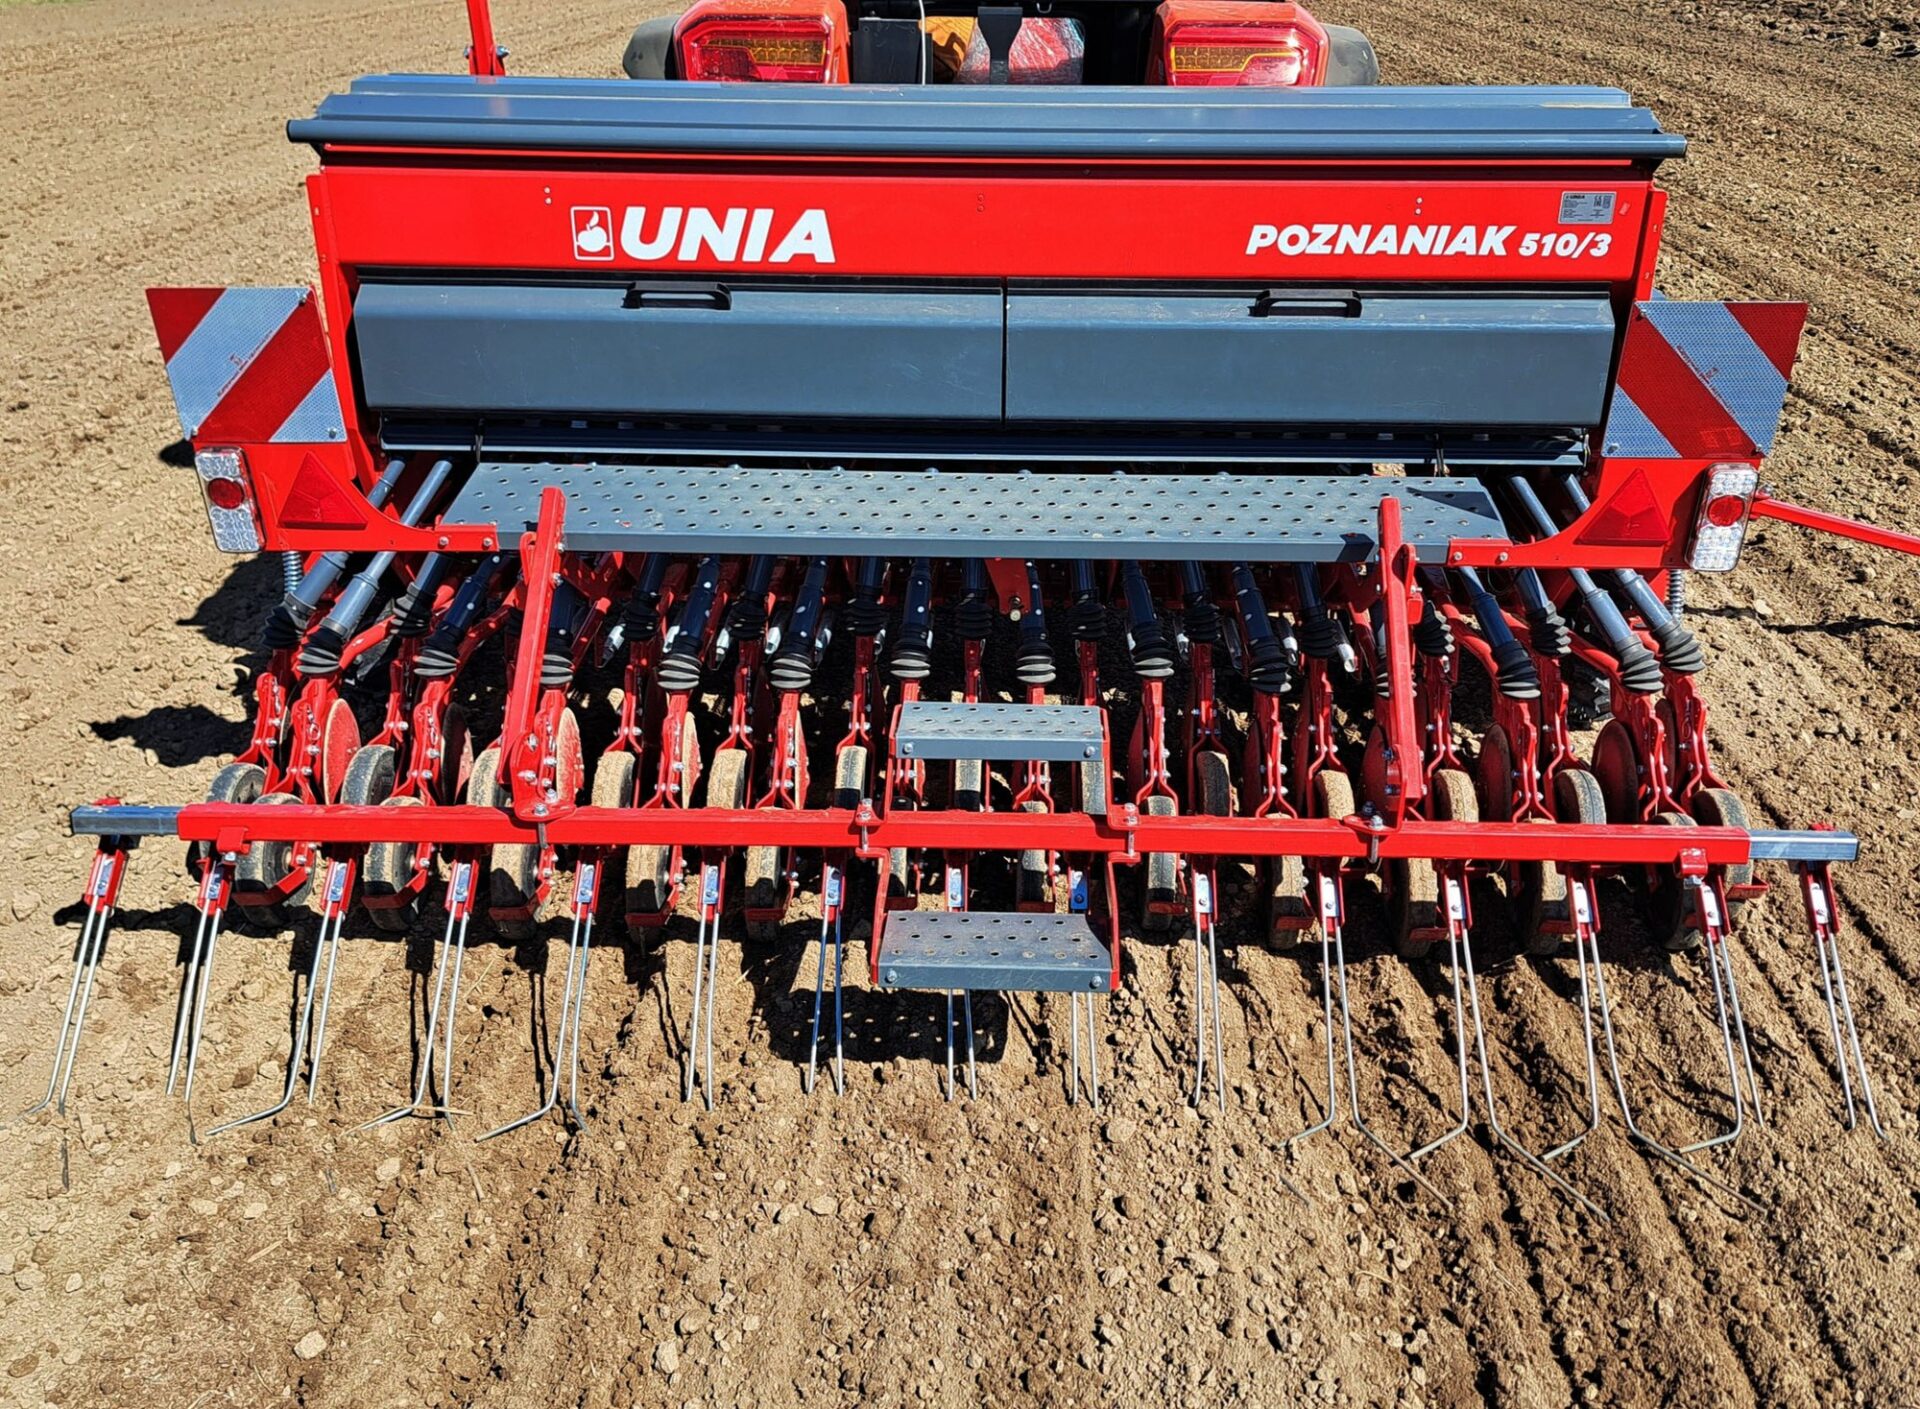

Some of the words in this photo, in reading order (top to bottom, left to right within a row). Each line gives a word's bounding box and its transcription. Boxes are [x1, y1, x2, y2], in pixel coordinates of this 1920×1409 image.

[620, 206, 835, 264] UNIA
[1245, 224, 1516, 256] POZNANIAK
[1518, 232, 1612, 259] 510/3
